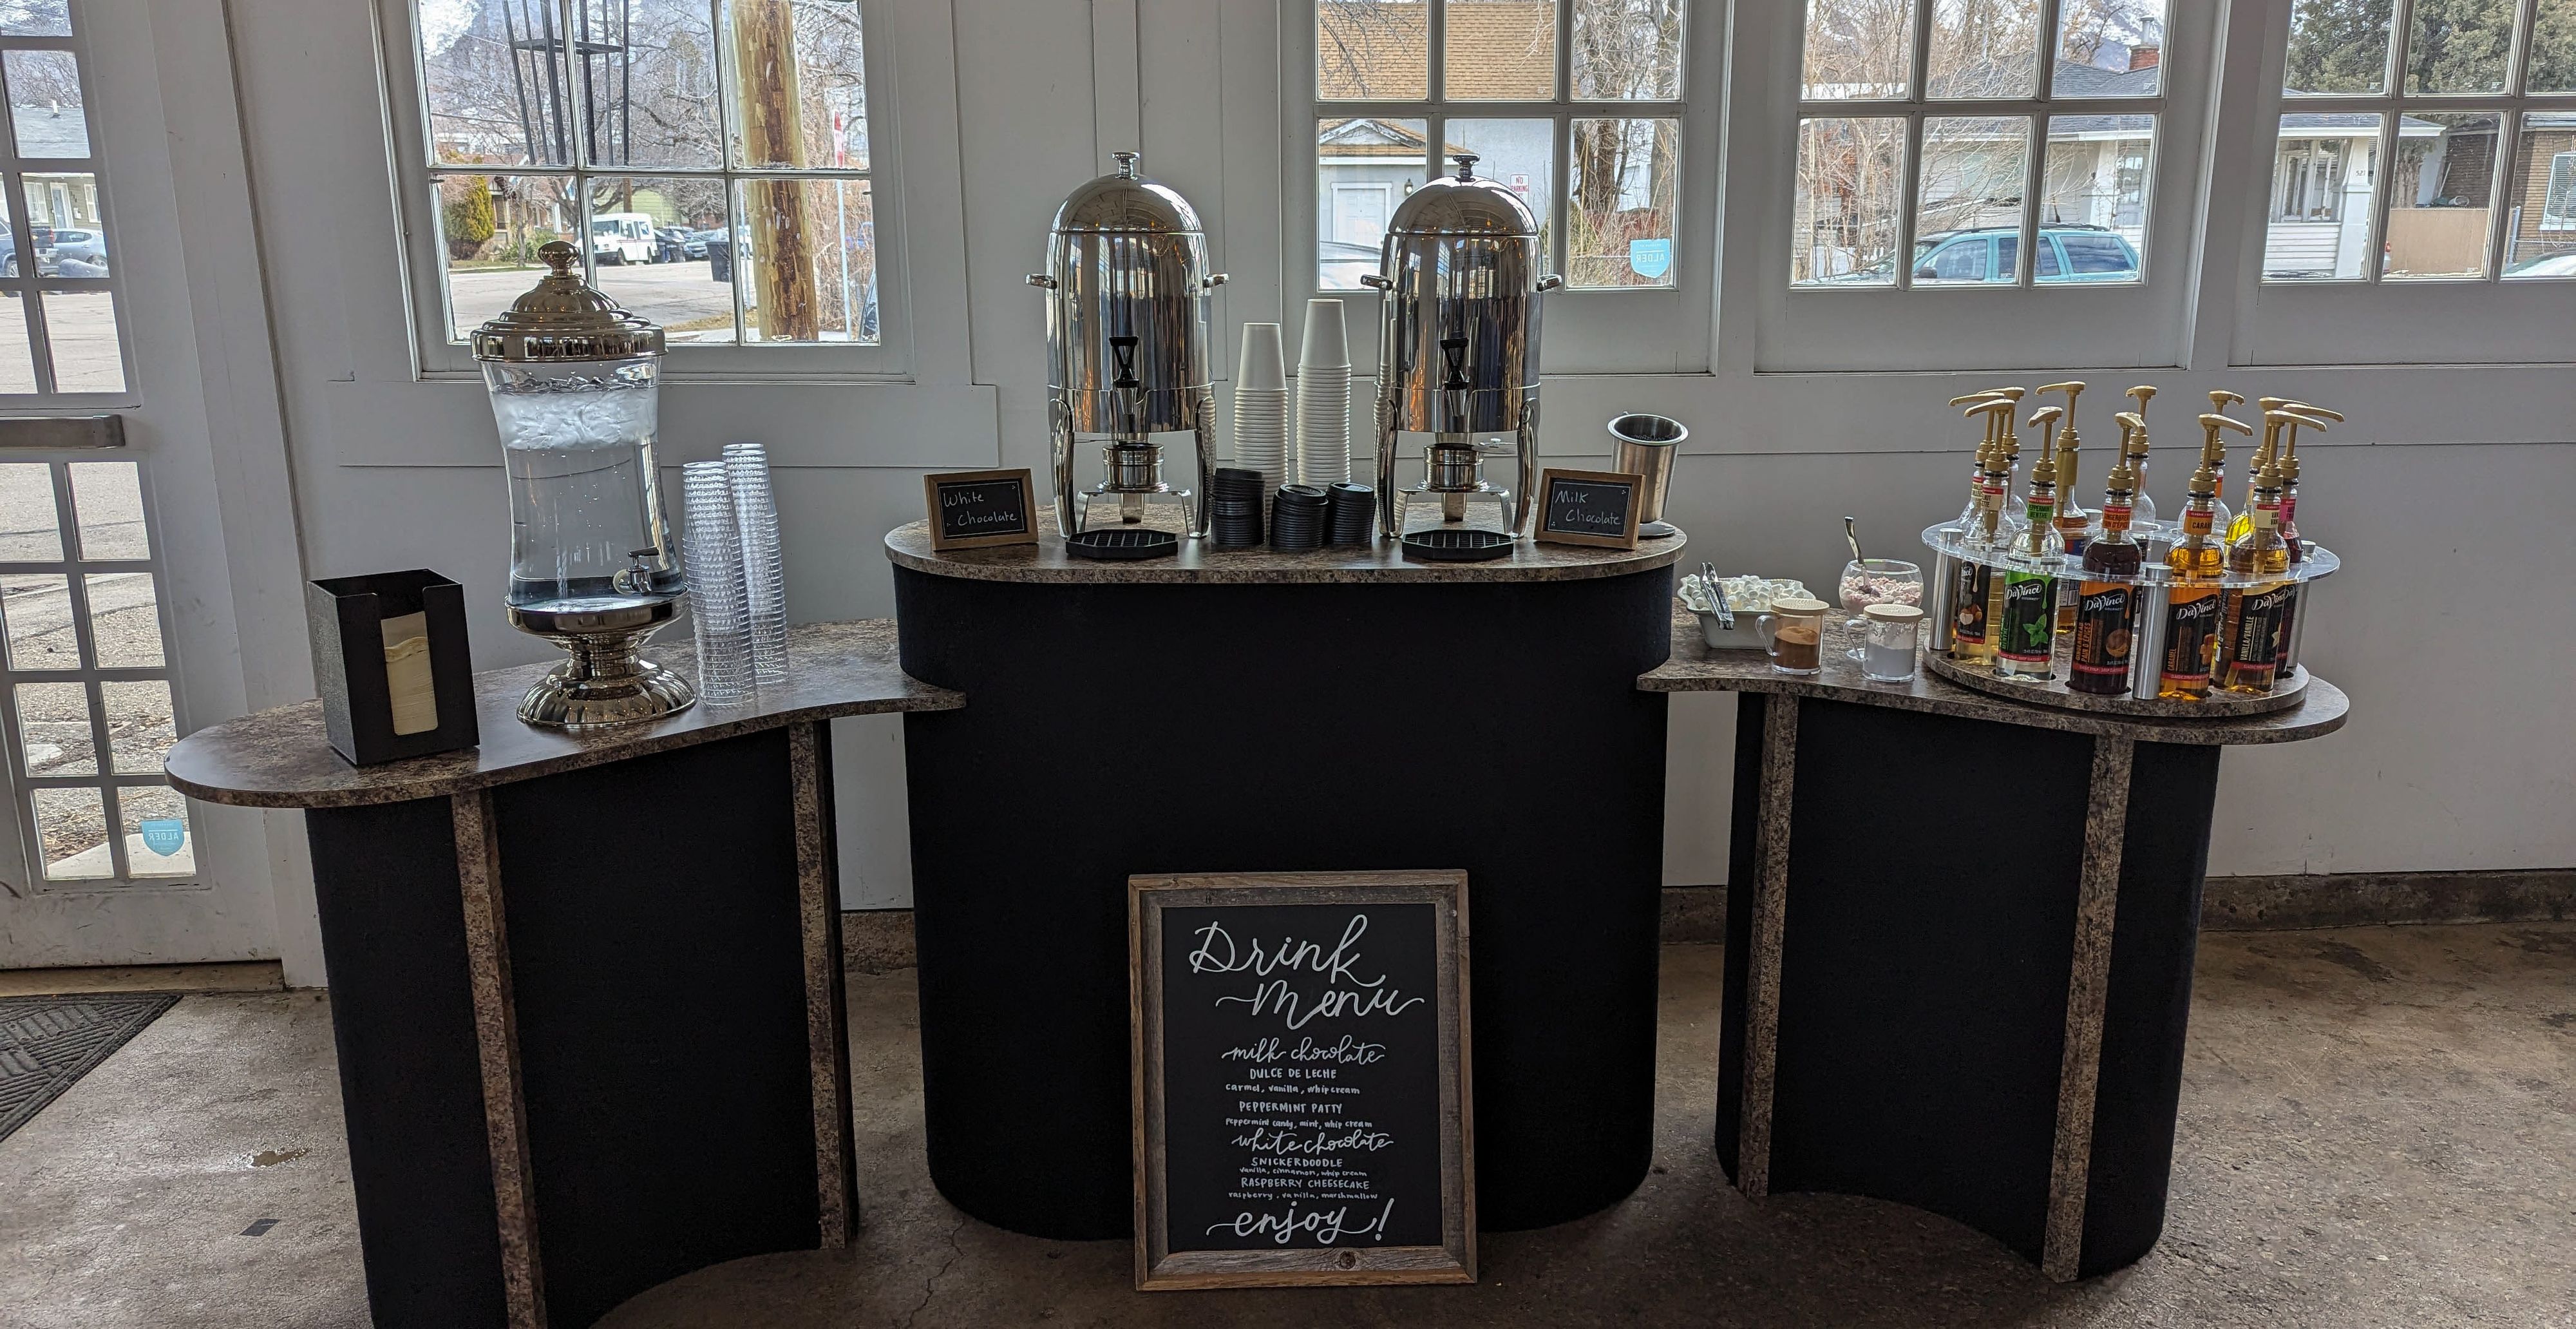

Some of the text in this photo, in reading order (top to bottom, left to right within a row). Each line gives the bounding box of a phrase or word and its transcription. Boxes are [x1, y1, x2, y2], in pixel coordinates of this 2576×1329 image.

[943, 492, 984, 507] White
[1555, 490, 1589, 504] Milk
[958, 511, 1018, 526] Chocolate
[1566, 509, 1620, 525] Chocolate
[2005, 584, 2042, 600] DaVinci
[2085, 593, 2125, 611] DaVinci
[2176, 599, 2217, 620] DaVinci
[1189, 914, 1386, 987] Drink
[1215, 979, 1425, 1030] Menu
[1221, 1035, 1386, 1065] milk chocolate
[1250, 1067, 1337, 1080] DULCE DE LECHE
[1239, 1101, 1343, 1114] PEPPERMINT PATTY
[1324, 1120, 1343, 1129] whip
[1231, 1127, 1394, 1155] white chocolate
[1251, 1157, 1343, 1167] SNICKERDOODLE
[1321, 1169, 1340, 1178] whip
[1241, 1177, 1370, 1190] RASPBERRY CHEESECAKE
